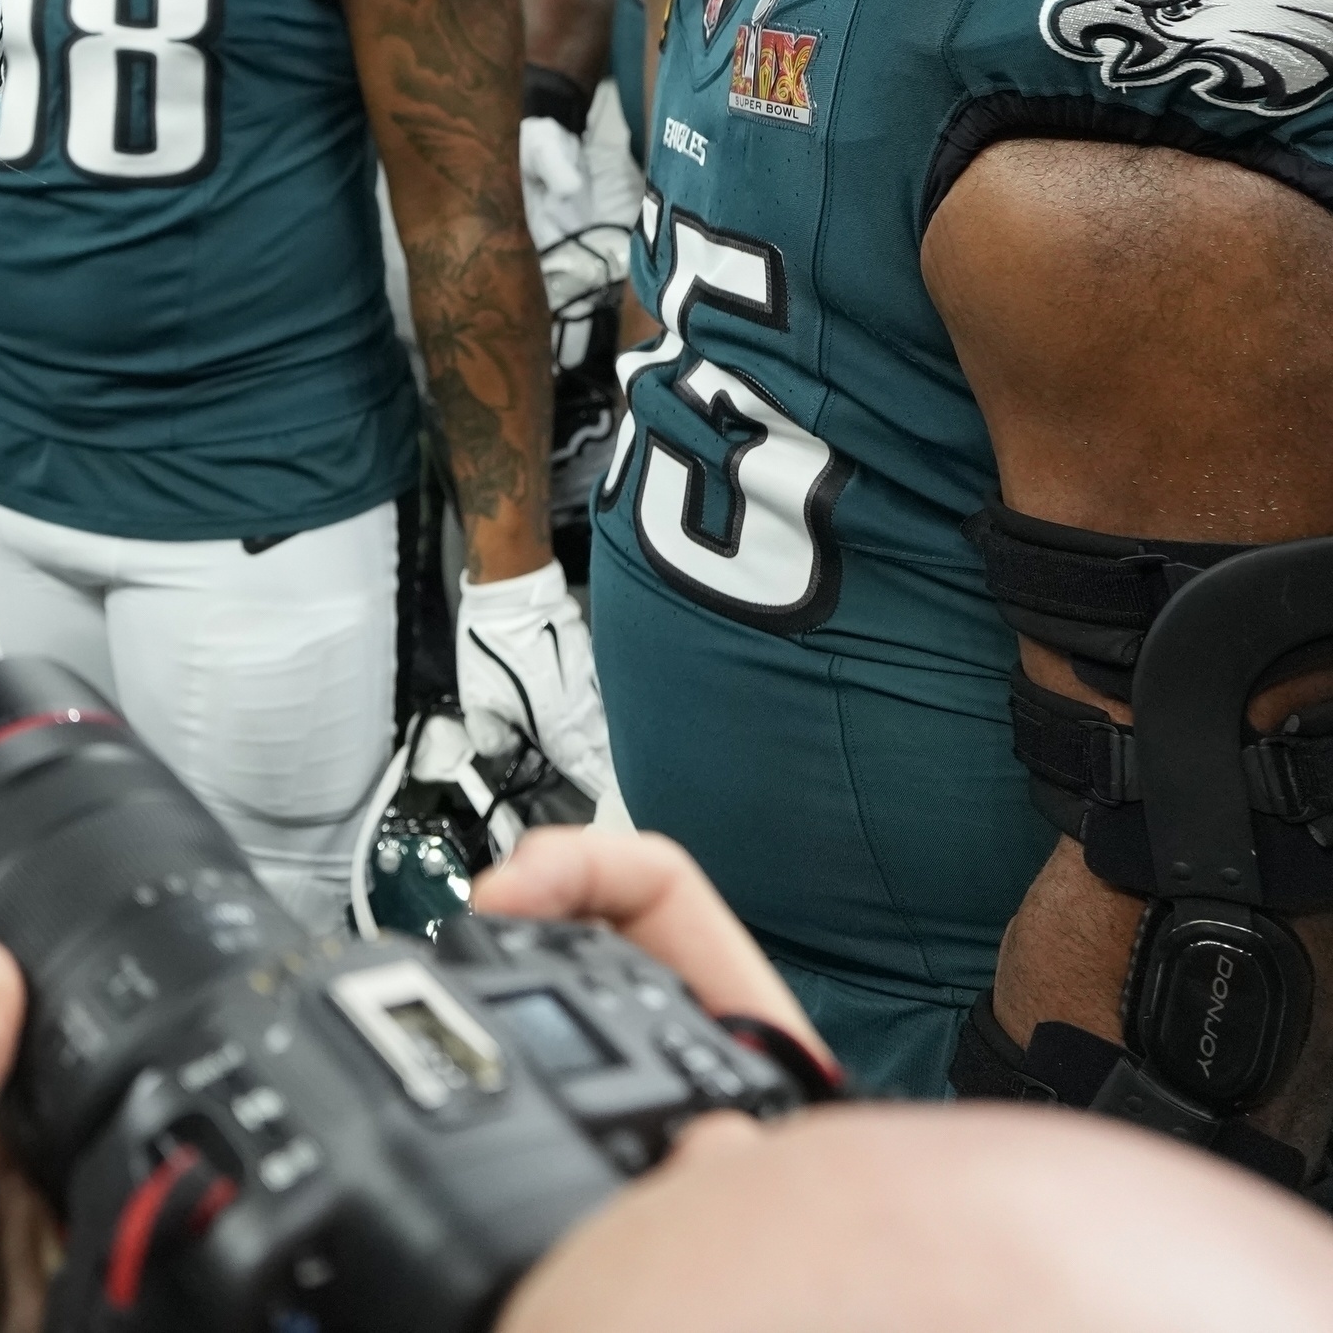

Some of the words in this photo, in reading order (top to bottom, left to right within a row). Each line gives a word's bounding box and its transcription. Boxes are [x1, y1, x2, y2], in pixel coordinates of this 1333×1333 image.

[733, 24, 818, 108] LIX
[734, 96, 762, 113] SUPER
[766, 103, 800, 120] BOWL
[662, 117, 708, 166] EAGLES
[598, 181, 845, 636] 5
